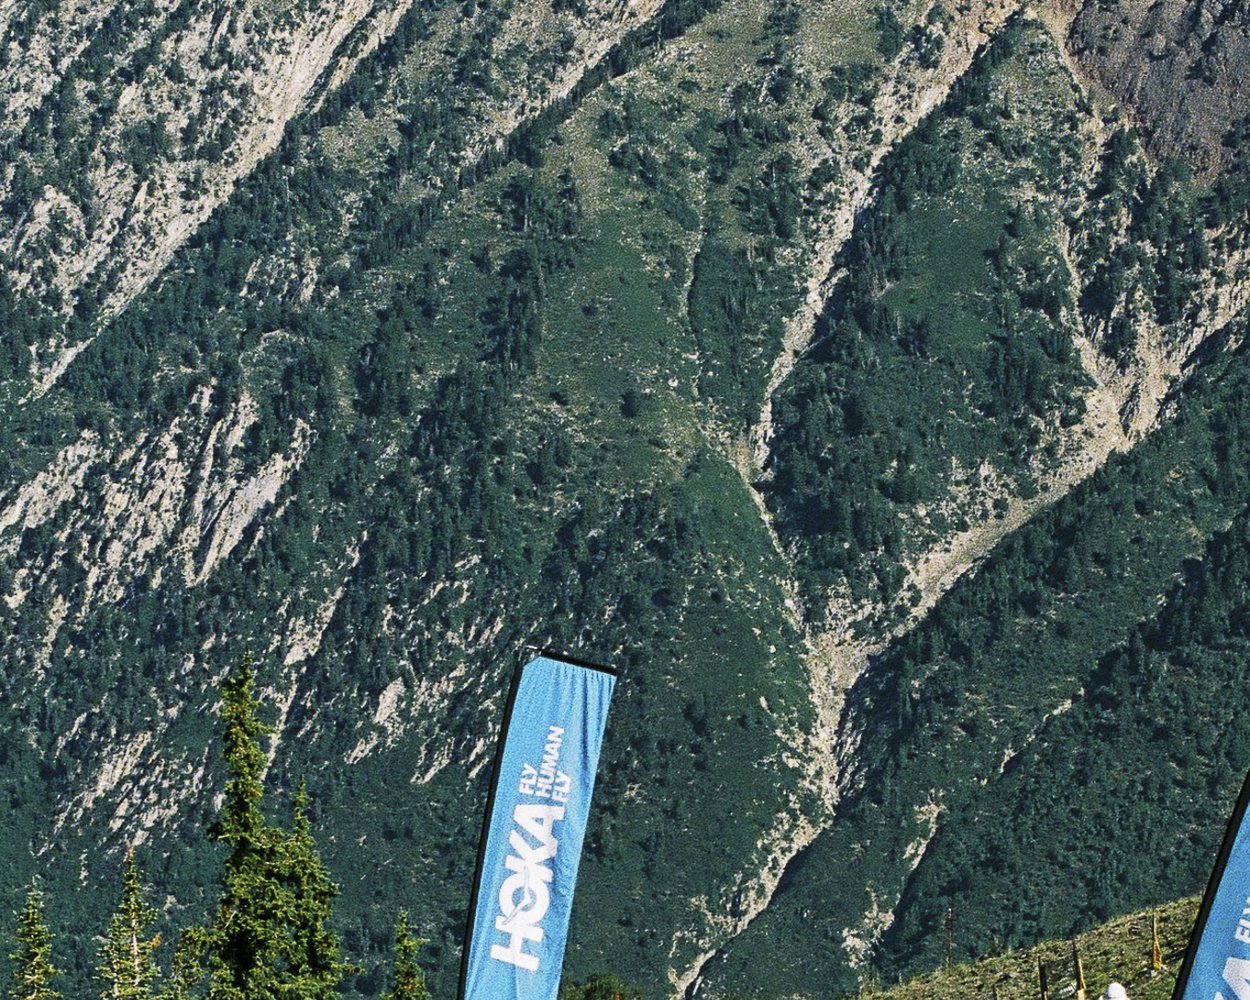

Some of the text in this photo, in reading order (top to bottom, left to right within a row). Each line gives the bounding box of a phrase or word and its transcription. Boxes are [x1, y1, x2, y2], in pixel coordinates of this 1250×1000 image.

[519, 762, 538, 795] FLY
[535, 725, 565, 797] HUMAN
[551, 770, 572, 803] FLY
[490, 803, 565, 972] HOKA
